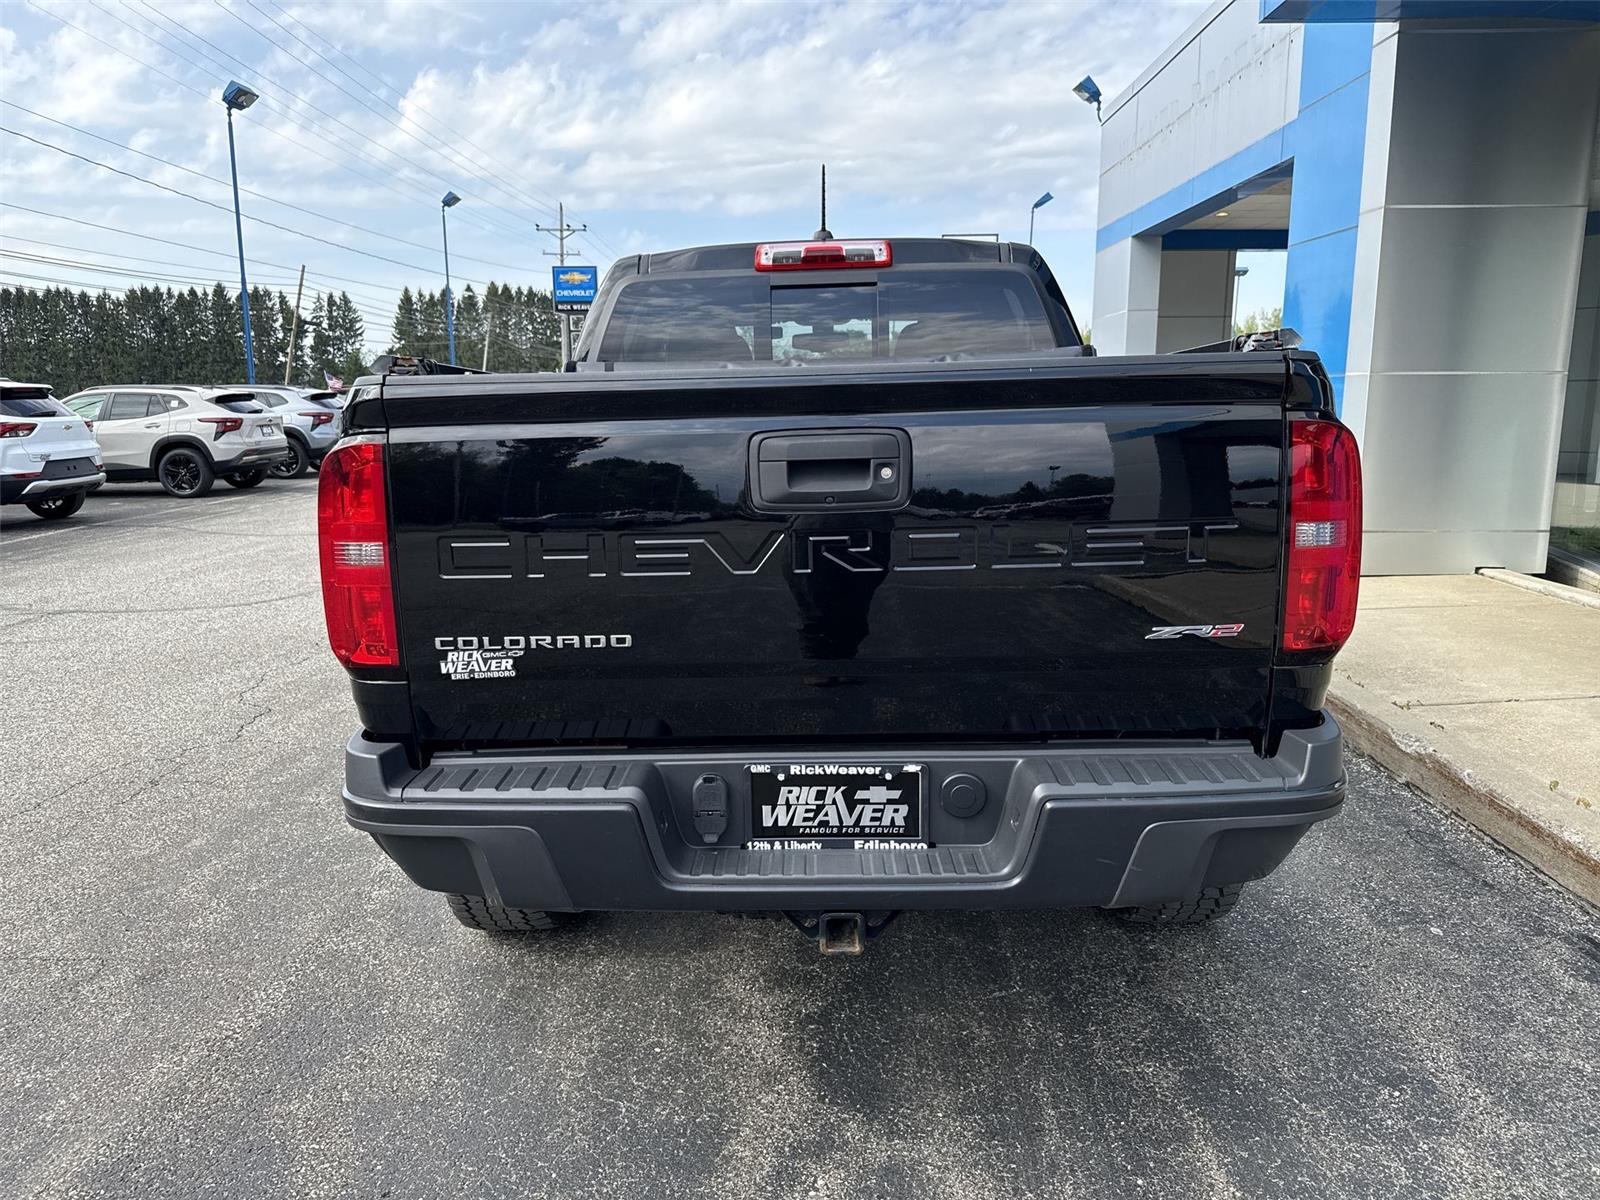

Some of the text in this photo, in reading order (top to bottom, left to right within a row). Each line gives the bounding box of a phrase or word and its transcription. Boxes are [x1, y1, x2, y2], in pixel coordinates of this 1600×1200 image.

[556, 289, 595, 297] CHEVROLET
[437, 523, 1239, 580] CHEVROLET
[1144, 623, 1245, 639] ZR2
[434, 634, 633, 650] COLORADO
[447, 650, 483, 663] RICK
[440, 659, 514, 674] WEAVER
[474, 670, 516, 679] EDINBORO
[750, 764, 771, 773] GMC
[790, 764, 882, 775] RickWeaver
[777, 786, 848, 805] RICK
[761, 804, 909, 827] WEAVER
[747, 841, 822, 850] 12th & Liberty
[854, 840, 928, 850] Edinboro
